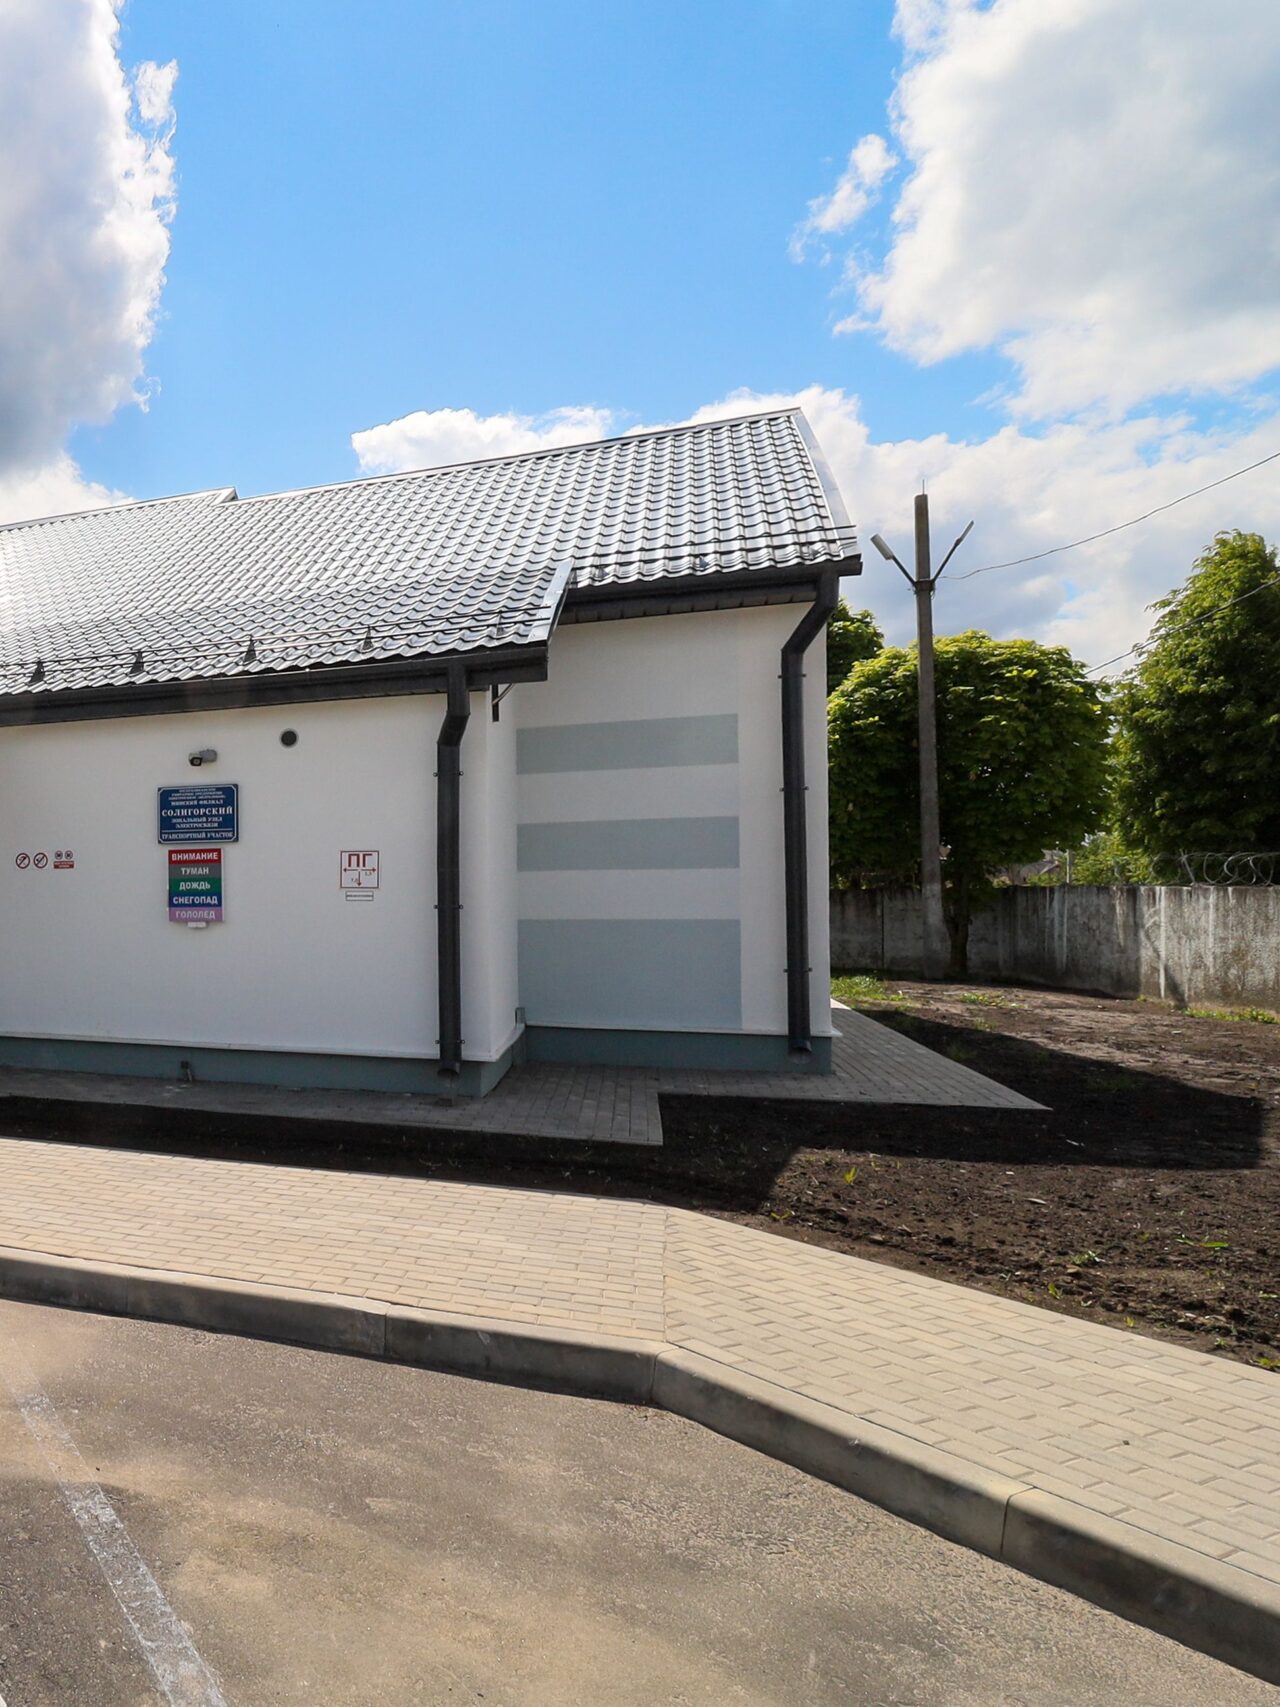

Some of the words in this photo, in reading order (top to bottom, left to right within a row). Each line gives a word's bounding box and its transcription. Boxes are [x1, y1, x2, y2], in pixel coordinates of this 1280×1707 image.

[161, 806, 233, 817] СОЛИГОРСКИЙ
[162, 832, 206, 840] ТРАНСПОРТНЫЙ
[171, 852, 218, 861] ВНИМАНИЕ
[348, 853, 372, 868] ПГ
[181, 867, 209, 875] ТУМАН
[179, 881, 211, 891] ДОЖДЬ
[172, 895, 218, 905] СНЕГОПАД
[176, 910, 216, 919] ГОЛОЛЕД
